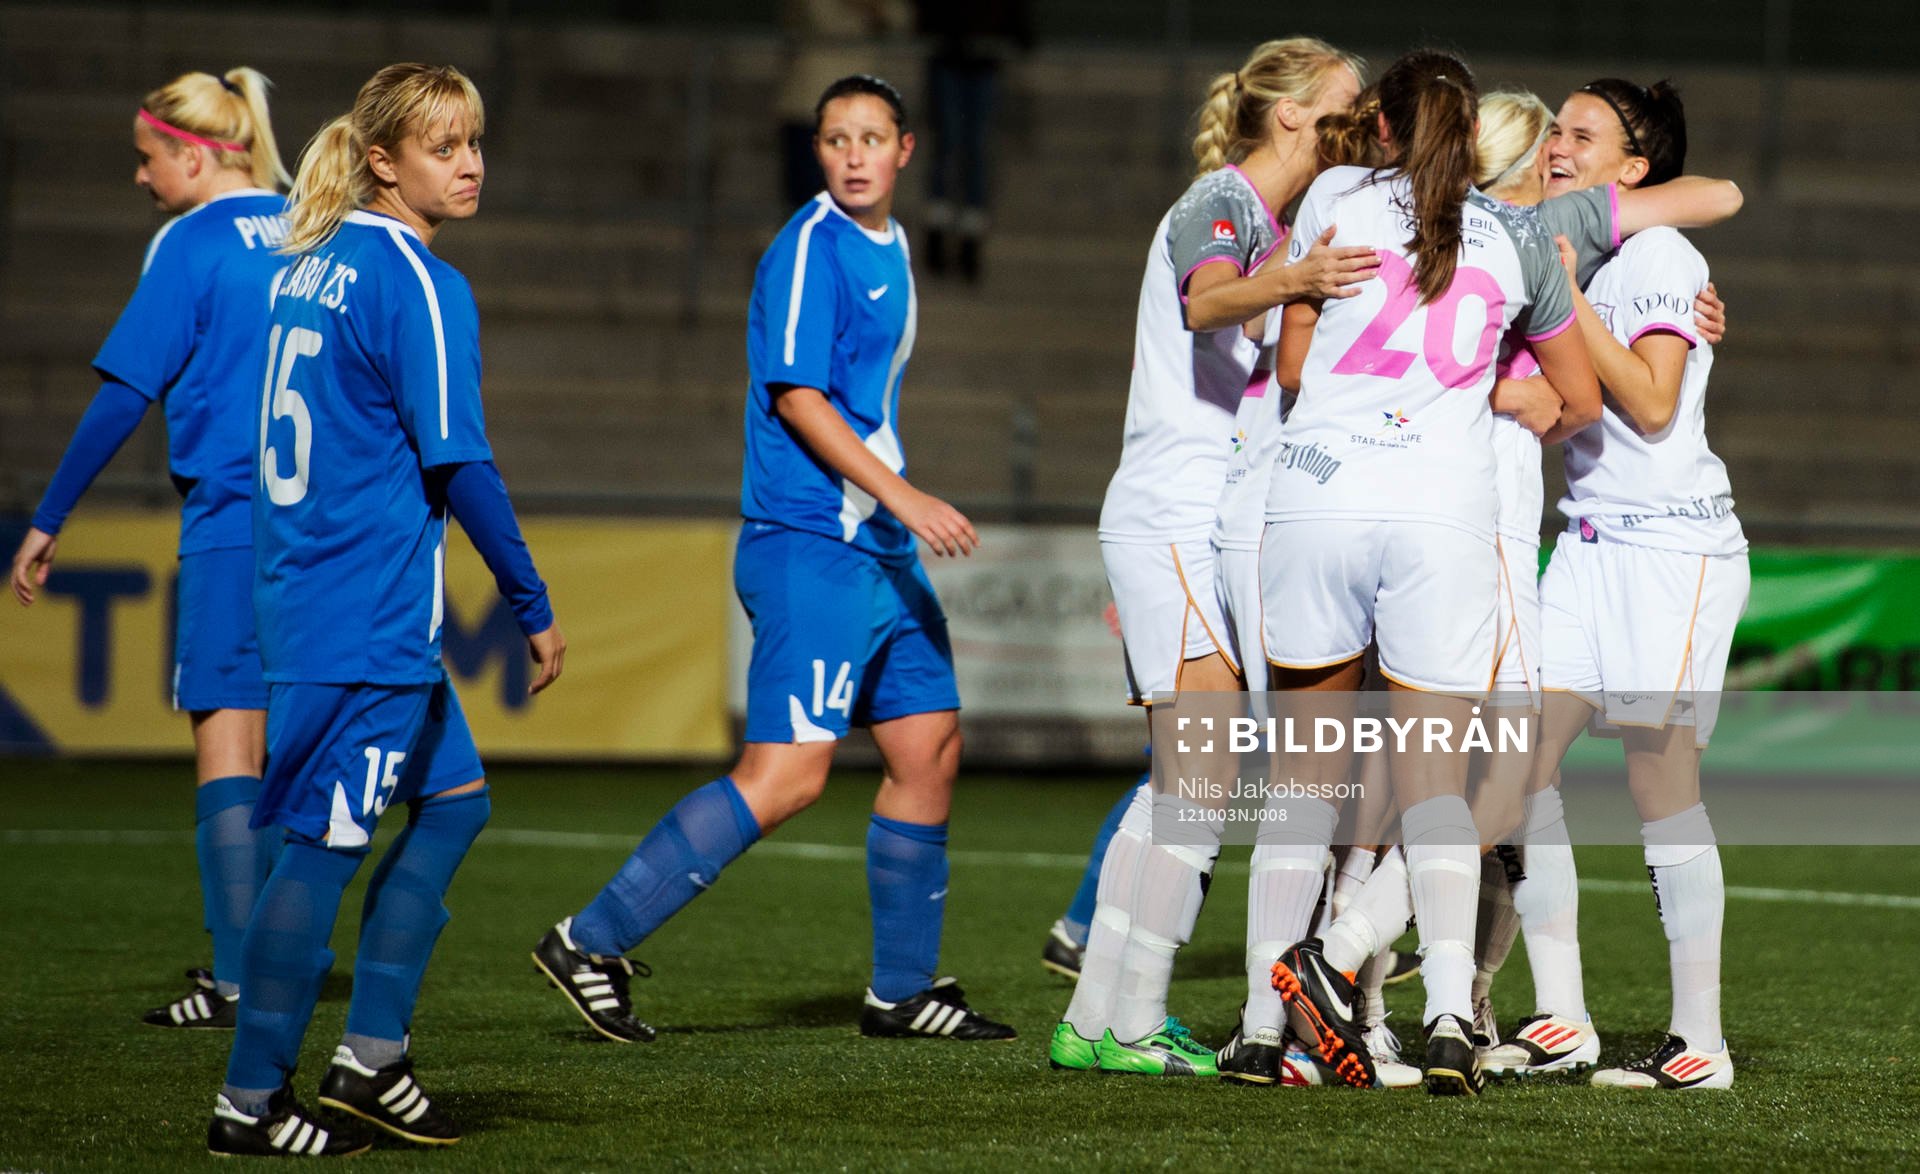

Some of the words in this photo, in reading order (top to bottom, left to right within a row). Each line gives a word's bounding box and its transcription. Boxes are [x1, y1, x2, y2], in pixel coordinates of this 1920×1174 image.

[1330, 249, 1506, 390] 20
[260, 323, 323, 507] 15
[1350, 434, 1376, 446] STAR
[1401, 433, 1422, 444] LIFE
[812, 658, 854, 719] 14
[363, 746, 406, 816] 15
